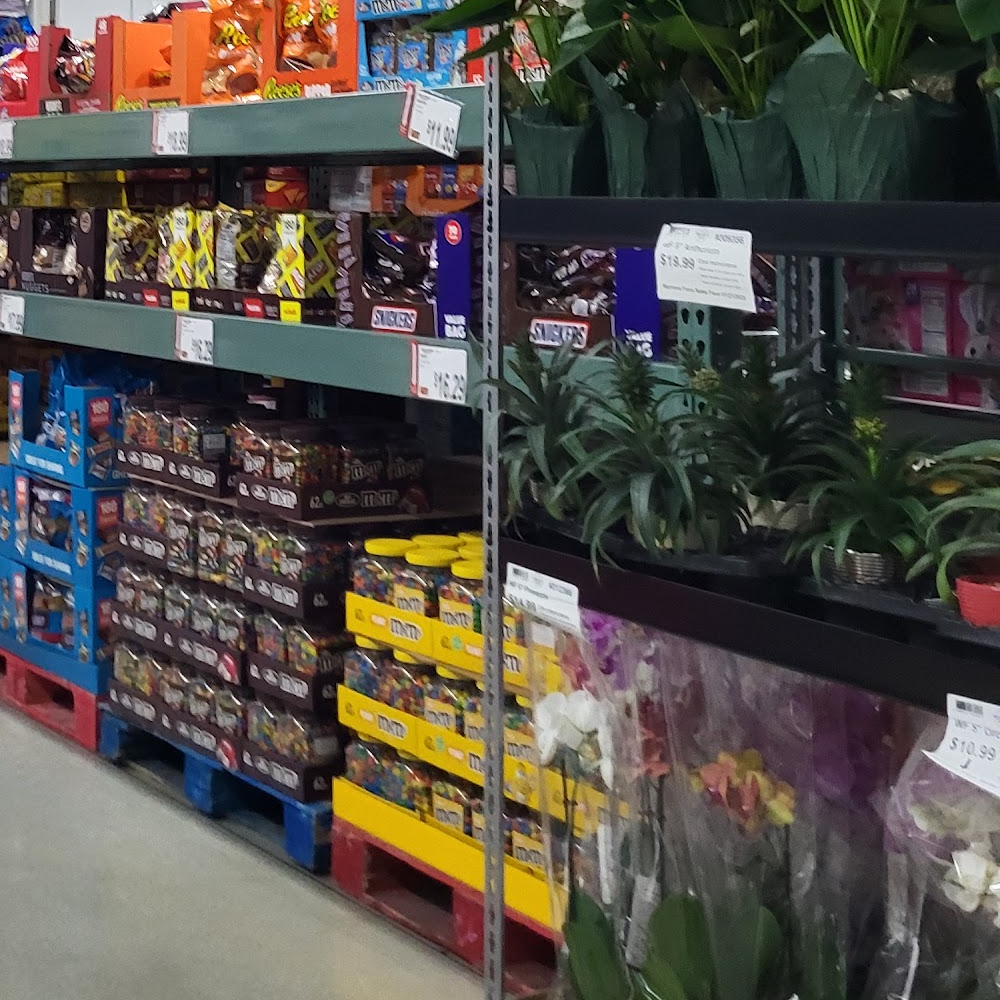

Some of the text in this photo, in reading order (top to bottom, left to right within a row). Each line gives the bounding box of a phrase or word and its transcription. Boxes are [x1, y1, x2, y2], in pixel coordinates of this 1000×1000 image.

[373, 308, 416, 331] SNICKERS
[444, 324, 467, 339] BAG
[948, 736, 997, 761] $10.99
